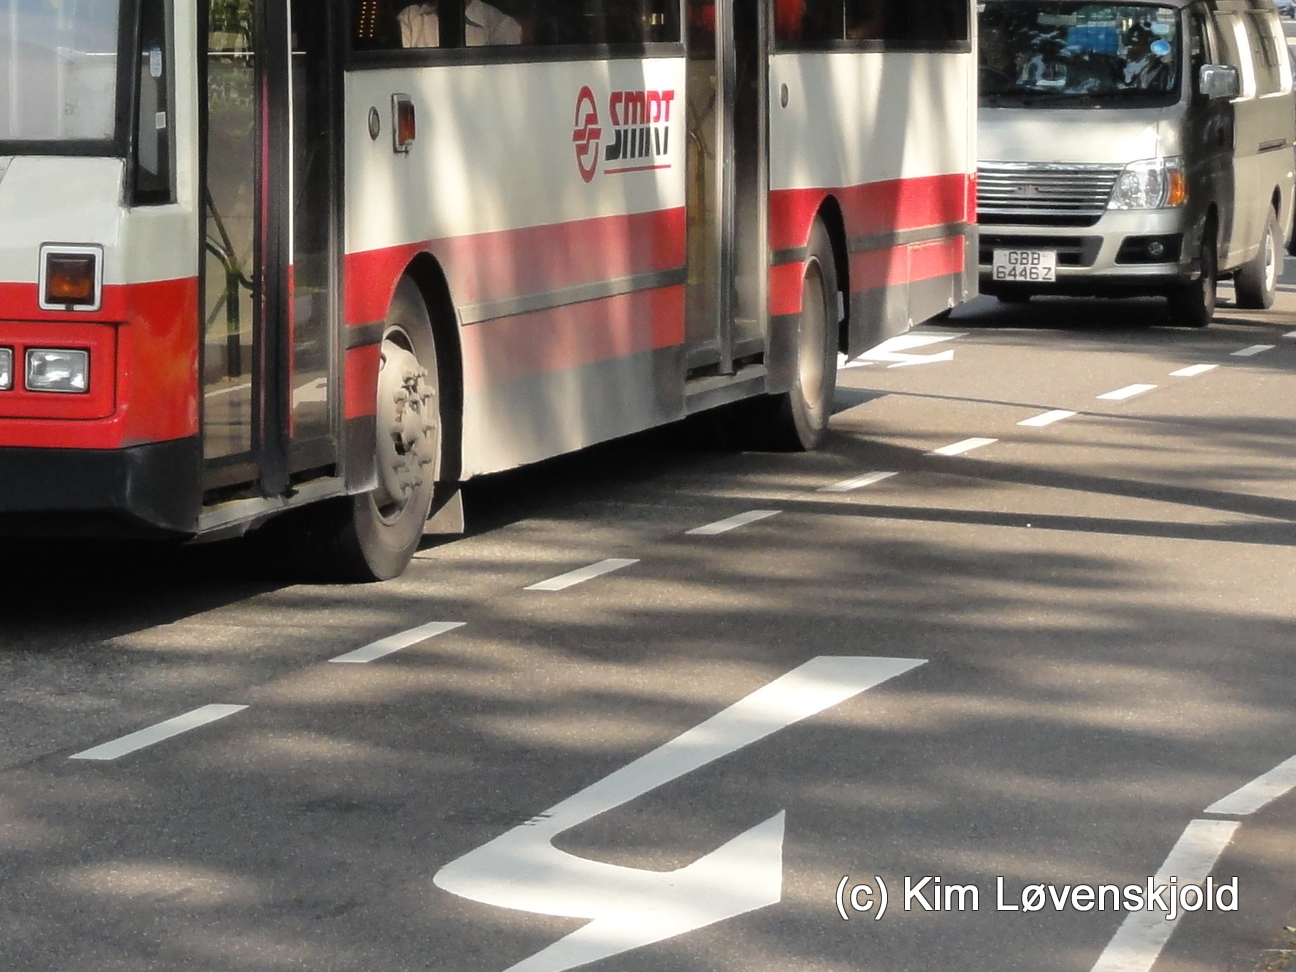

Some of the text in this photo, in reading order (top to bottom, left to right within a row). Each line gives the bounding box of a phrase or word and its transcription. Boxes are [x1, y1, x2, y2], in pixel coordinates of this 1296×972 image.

[604, 90, 674, 161] SMRT
[1008, 251, 1040, 266] GBB
[996, 265, 1053, 281] 6446Z
